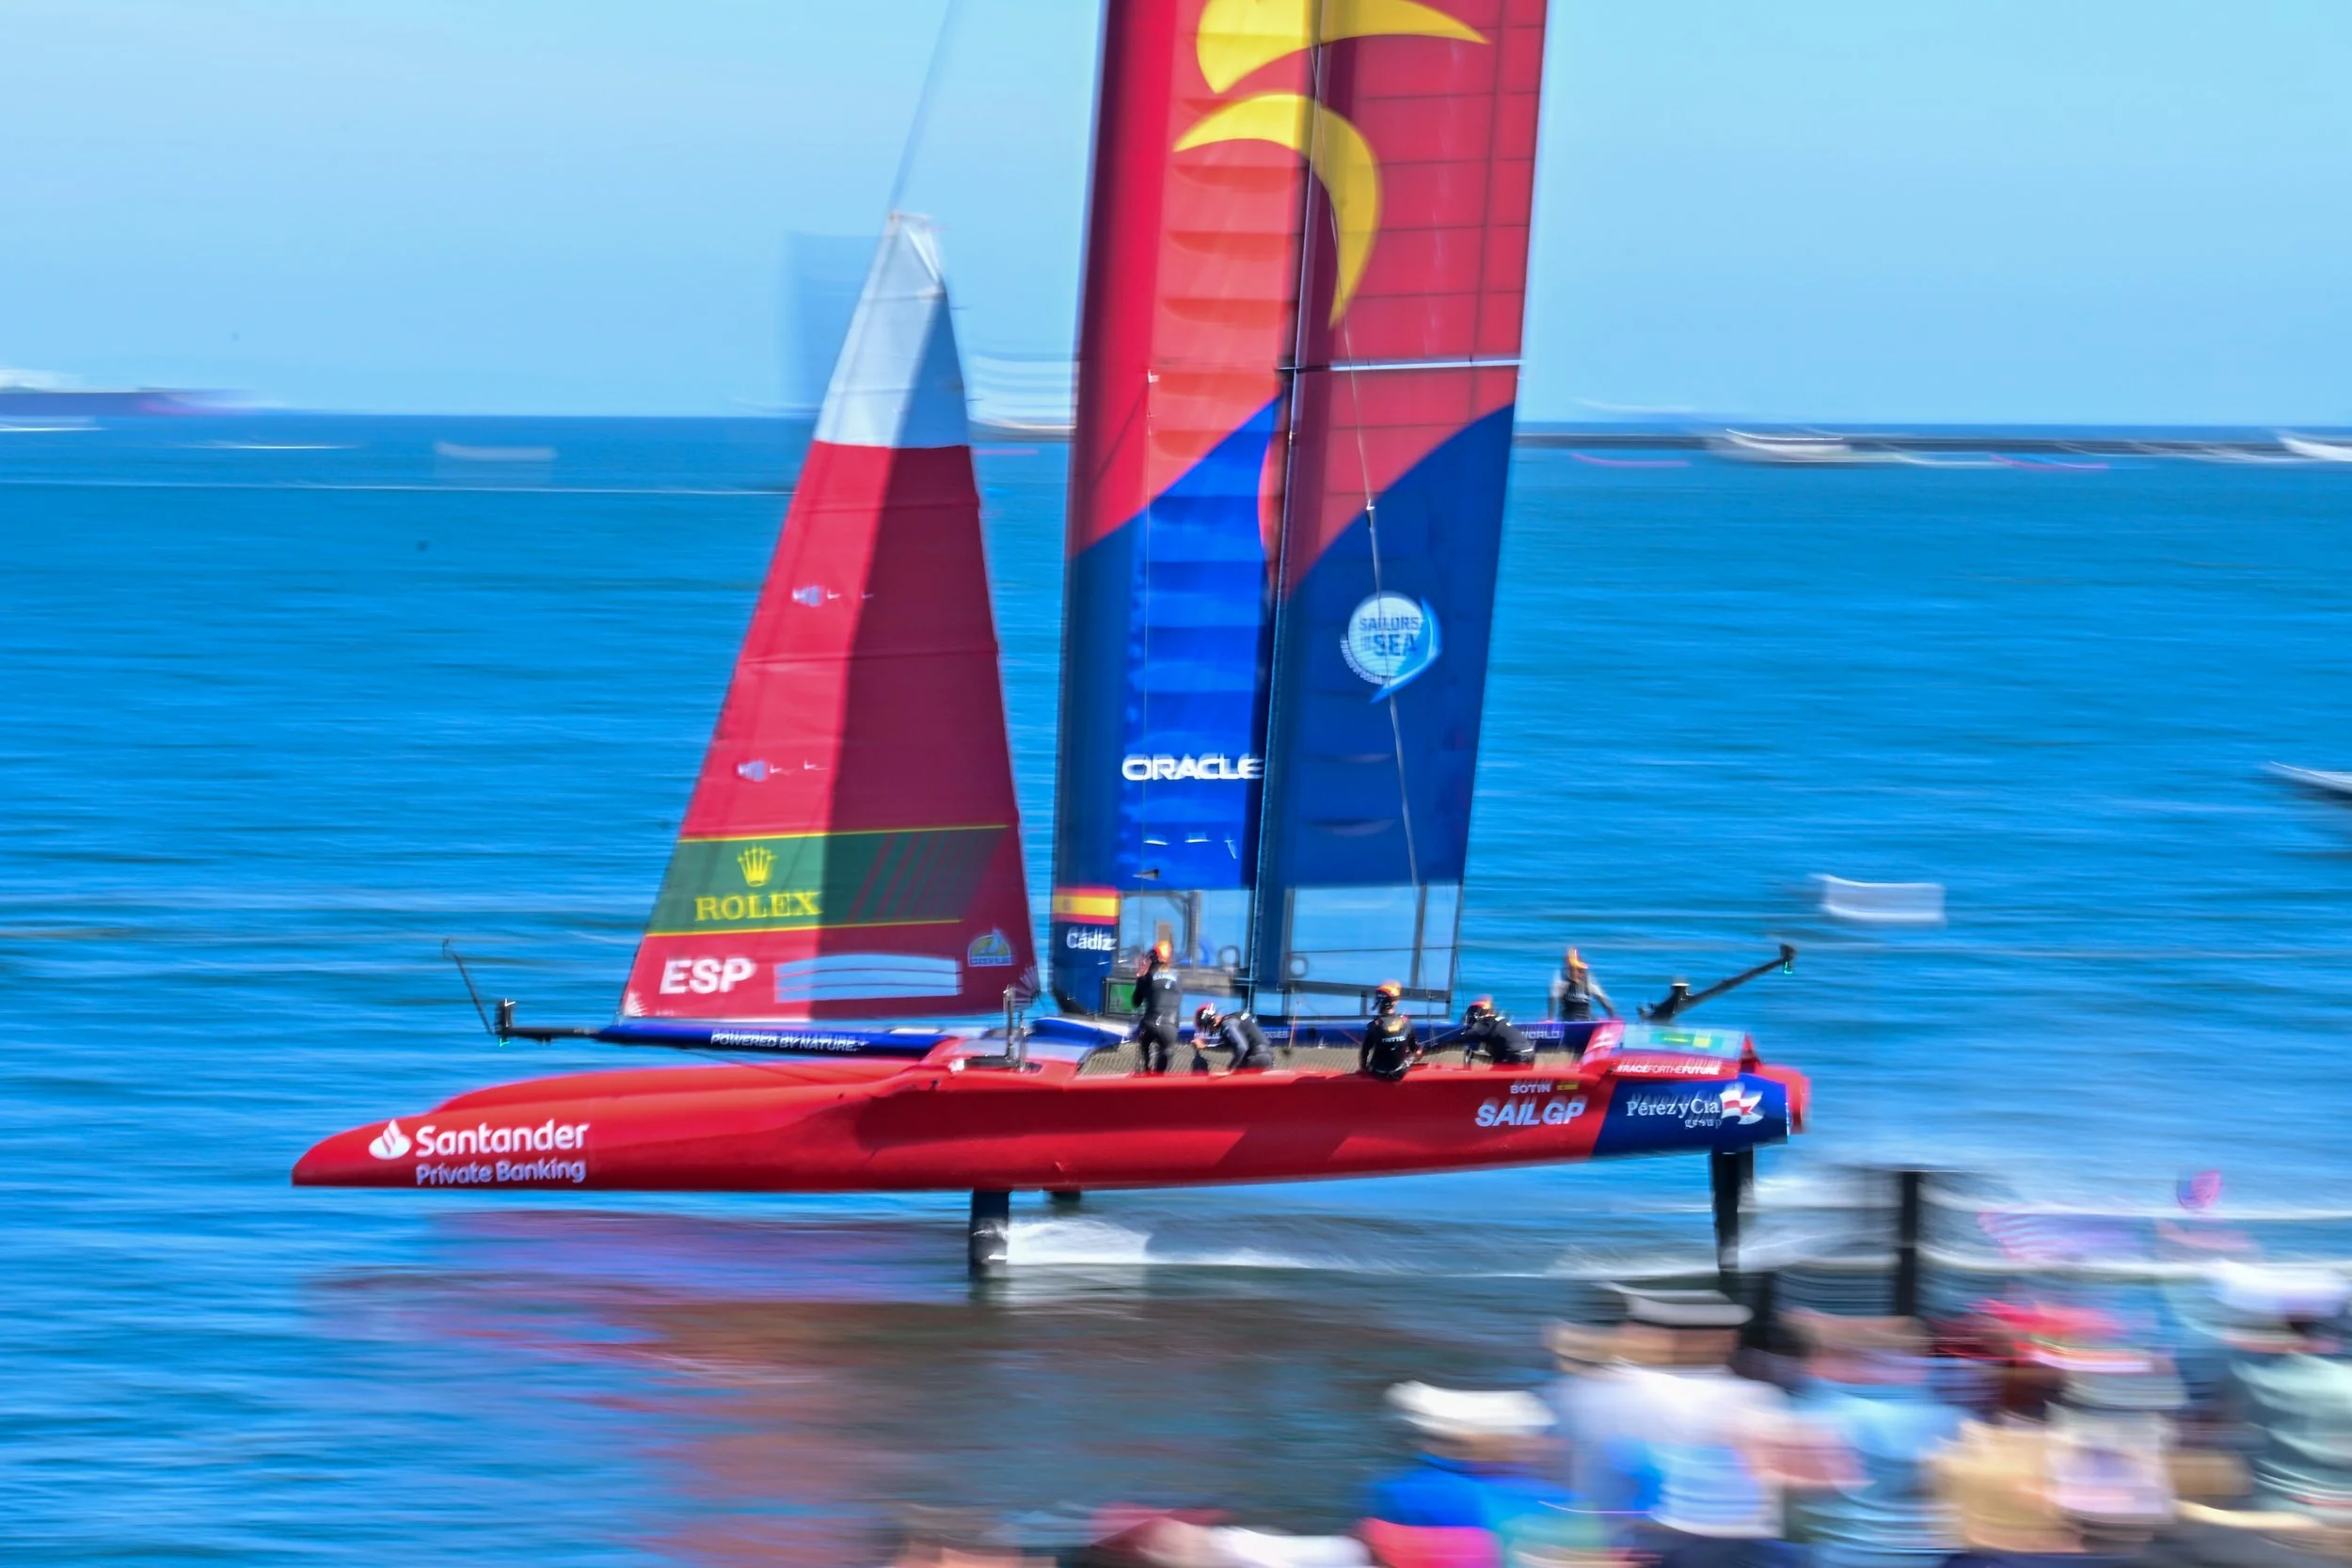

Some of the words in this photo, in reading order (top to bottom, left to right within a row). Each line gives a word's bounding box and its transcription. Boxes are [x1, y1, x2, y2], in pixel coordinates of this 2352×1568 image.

[1359, 616, 1420, 631] SAILORS
[1374, 634, 1417, 657] SEA
[1122, 755, 1264, 781] ORACLE
[694, 891, 823, 922] ROLEX
[660, 957, 756, 994] ESP
[710, 1033, 777, 1048] POWERED
[779, 1037, 799, 1049] BY
[415, 1118, 591, 1158] Santander
[416, 1162, 494, 1186] Private
[495, 1157, 586, 1184] Banking
